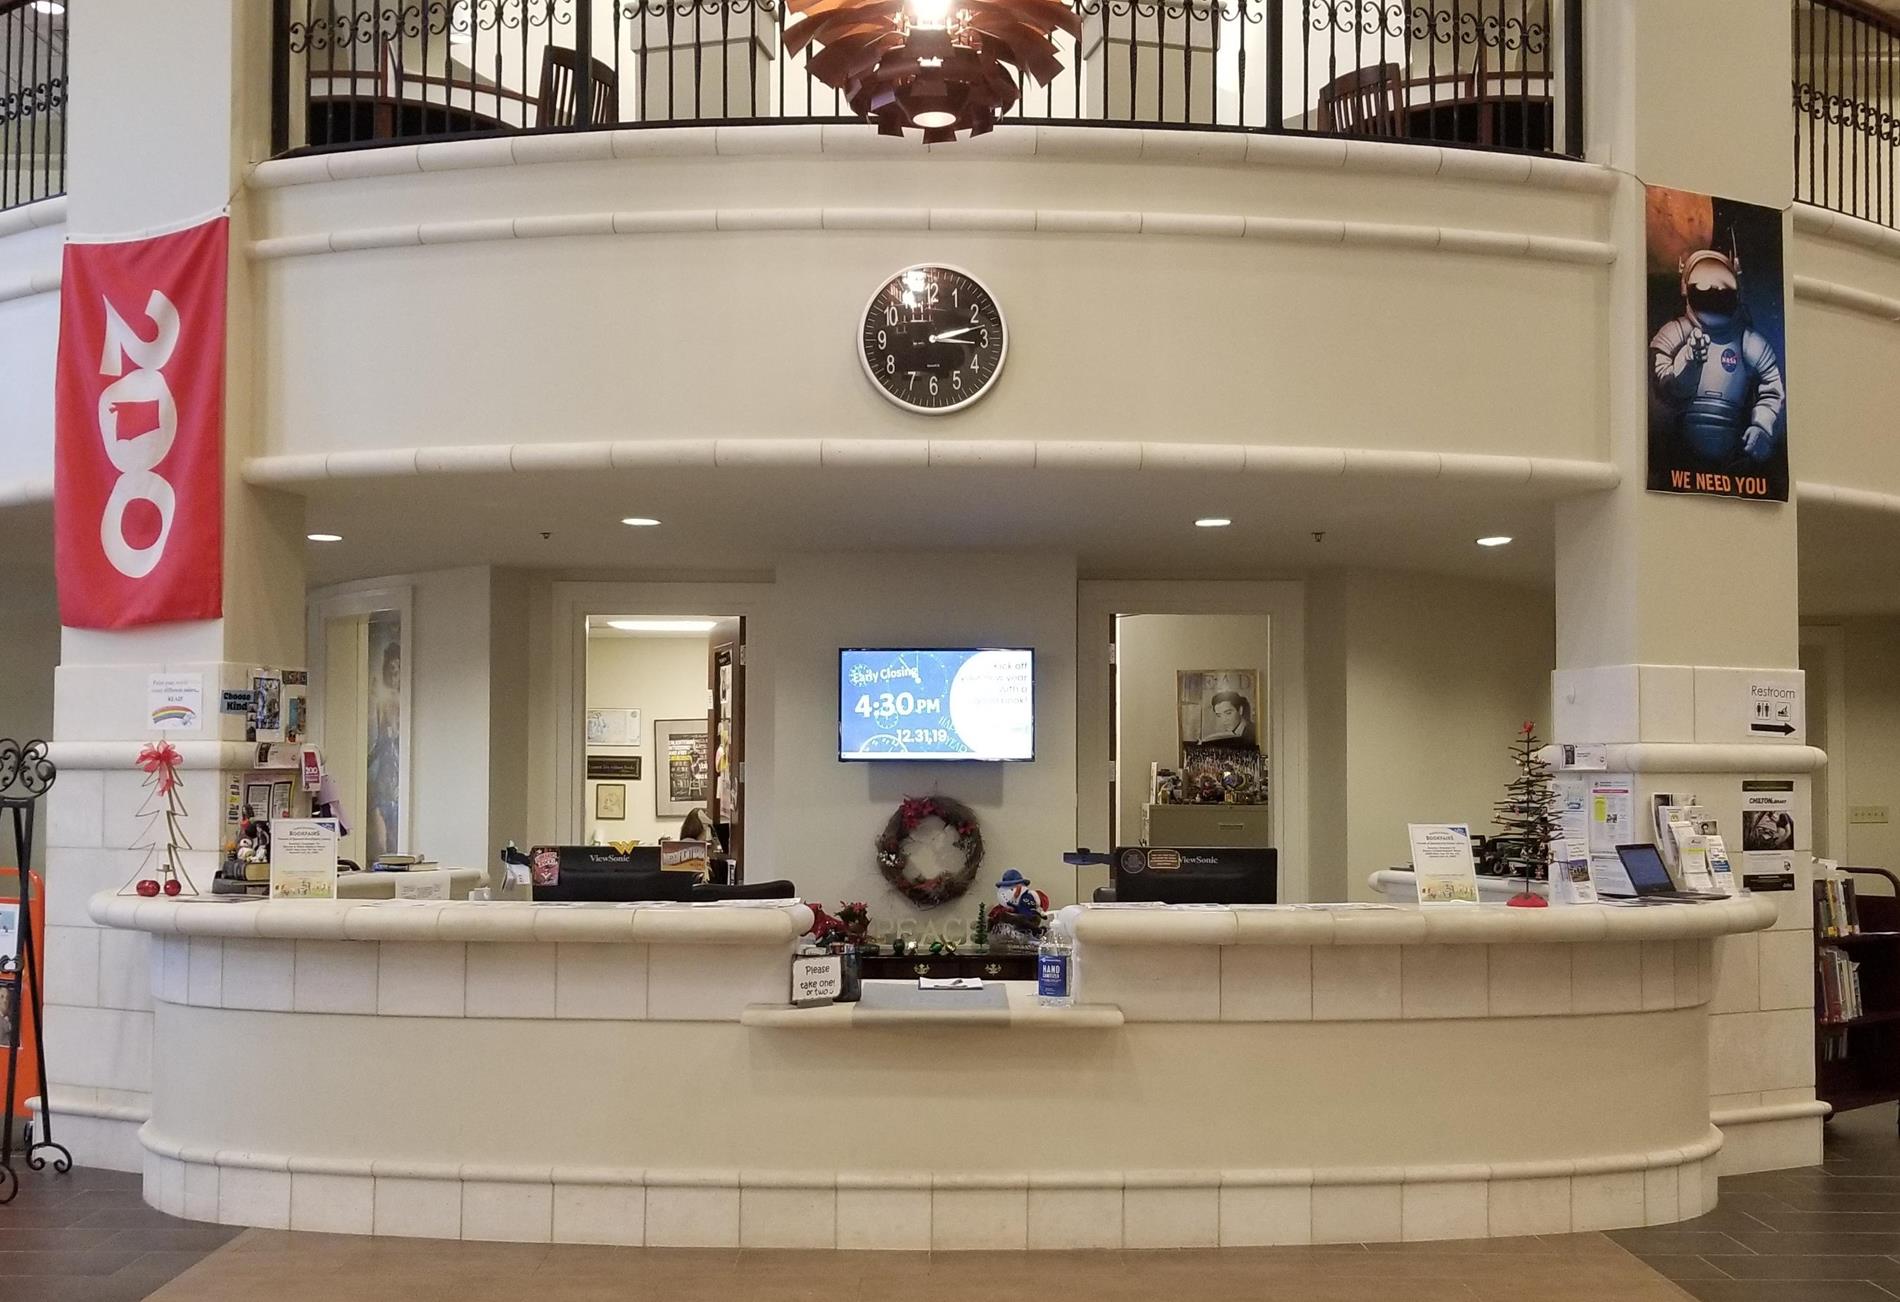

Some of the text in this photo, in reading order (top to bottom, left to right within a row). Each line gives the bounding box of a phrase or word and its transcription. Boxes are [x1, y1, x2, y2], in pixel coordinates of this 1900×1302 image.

[926, 283, 939, 303] 12
[952, 289, 958, 308] 1
[884, 306, 898, 326] 10
[970, 304, 979, 324] 2
[877, 330, 887, 350] 9
[980, 329, 989, 349] 3
[886, 355, 896, 374] 8
[970, 354, 980, 374] 4
[1722, 356, 1737, 365] NASA
[908, 371, 917, 391] 7
[929, 376, 939, 396] 6
[952, 371, 962, 390] 5
[1671, 470, 1767, 495] WE NEED YOU
[853, 667, 919, 684] Early Closing
[223, 692, 251, 700] Choose
[1751, 685, 1796, 699] Restroom
[226, 701, 248, 710] Kind
[855, 691, 914, 718] 4:30
[917, 699, 940, 713] PM
[590, 854, 630, 863] ViewSonic
[805, 965, 830, 975] Please
[1042, 964, 1060, 974] HAND
[800, 980, 817, 989] take
[814, 988, 828, 996] two
